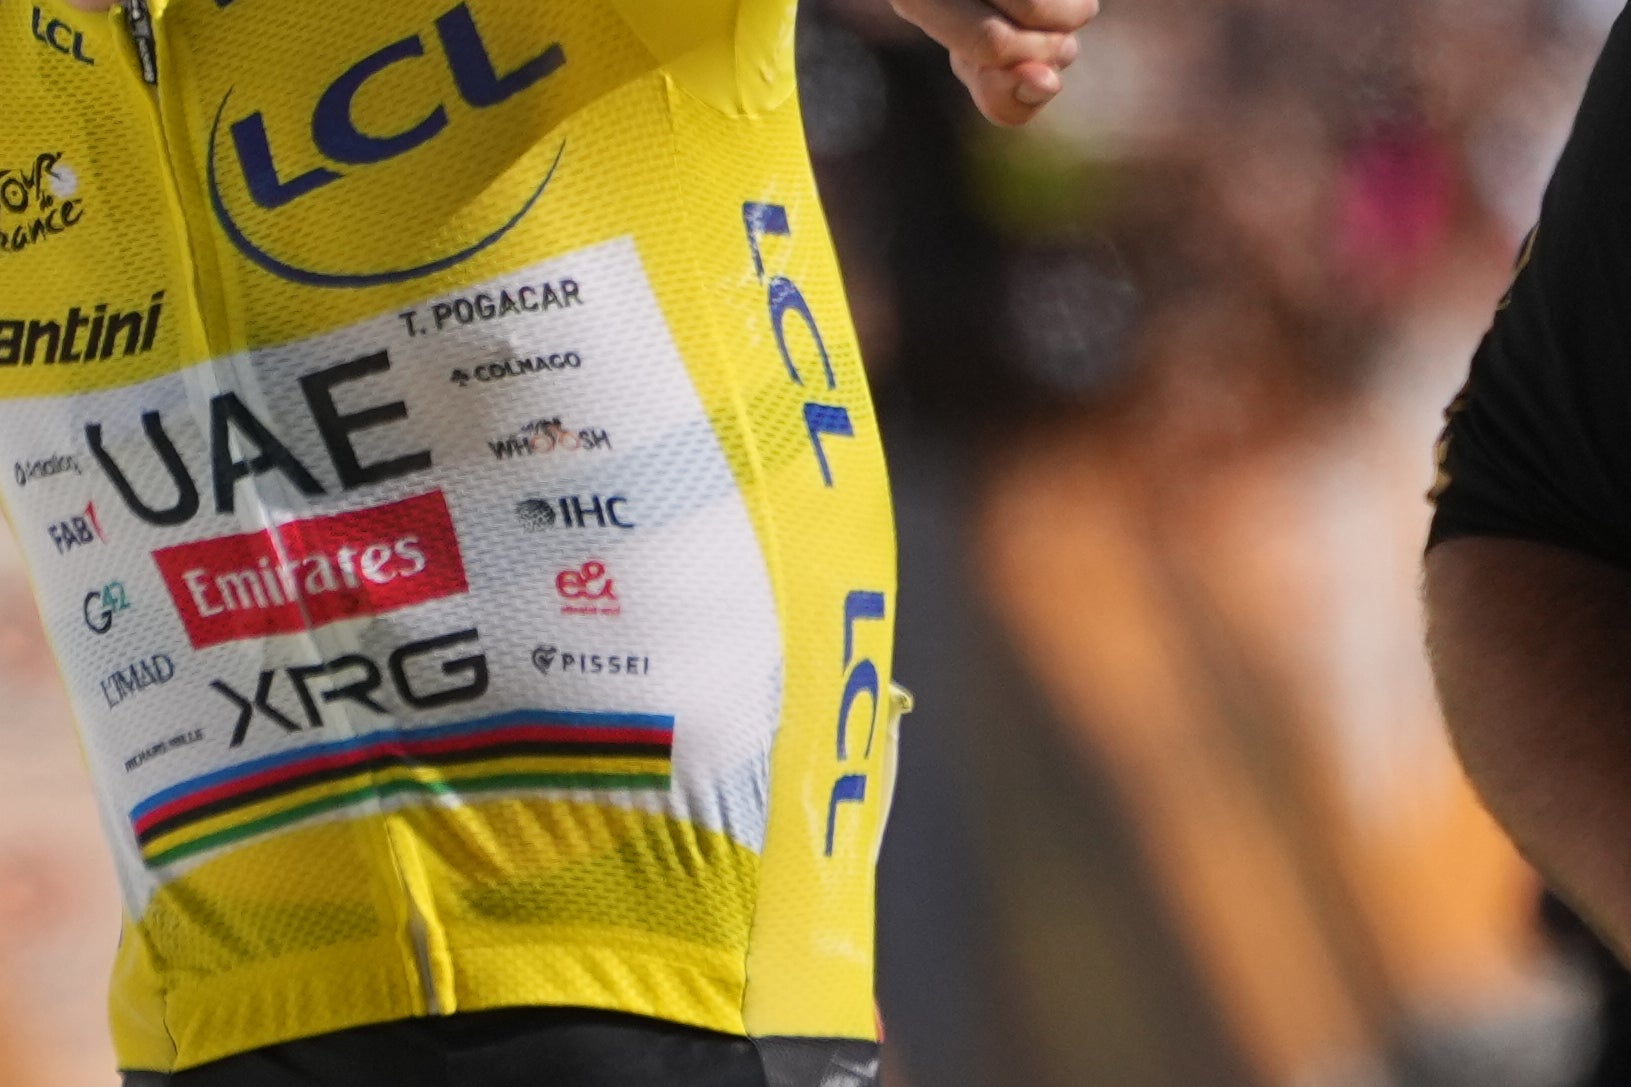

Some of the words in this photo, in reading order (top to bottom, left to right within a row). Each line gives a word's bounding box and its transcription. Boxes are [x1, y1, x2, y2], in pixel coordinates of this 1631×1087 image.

[32, 5, 95, 66] LCL
[230, 1, 567, 212] LCL
[399, 312, 426, 338] T.
[432, 279, 584, 331] POGACAR
[742, 200, 854, 488] LCL
[473, 352, 582, 382] COLNAGO
[84, 350, 432, 526] UAE
[558, 495, 635, 529] IHC
[83, 581, 131, 634] G42
[183, 535, 427, 619] Emirates
[210, 628, 490, 748] XRG
[561, 652, 649, 675] PISSEI
[825, 590, 885, 857] LCL
